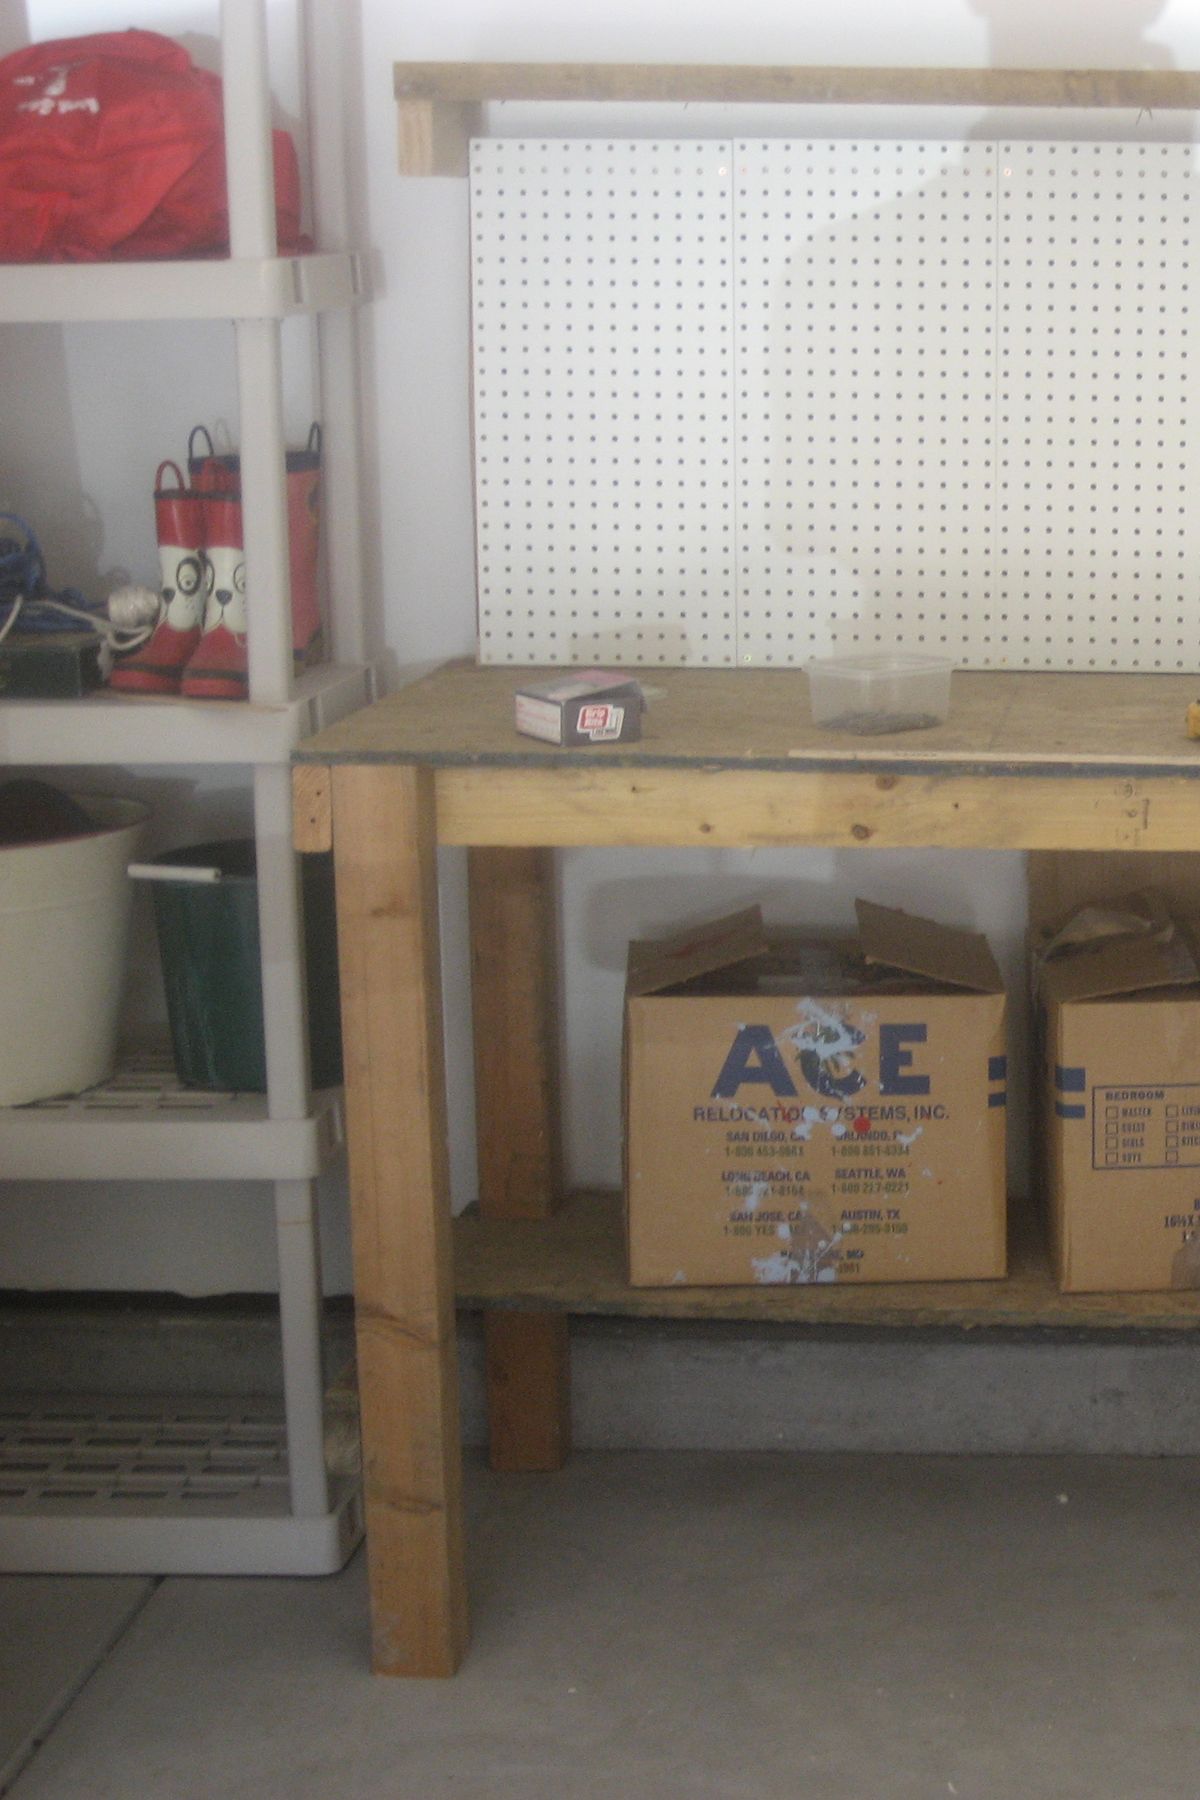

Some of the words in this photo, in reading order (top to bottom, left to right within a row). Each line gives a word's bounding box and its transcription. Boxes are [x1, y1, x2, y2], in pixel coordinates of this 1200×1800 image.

[710, 1022, 930, 1098] ACE
[1105, 1090, 1165, 1101] BEDROOM
[914, 1104, 950, 1120] INC.
[886, 1167, 906, 1178] WA
[885, 1208, 901, 1219] TX
